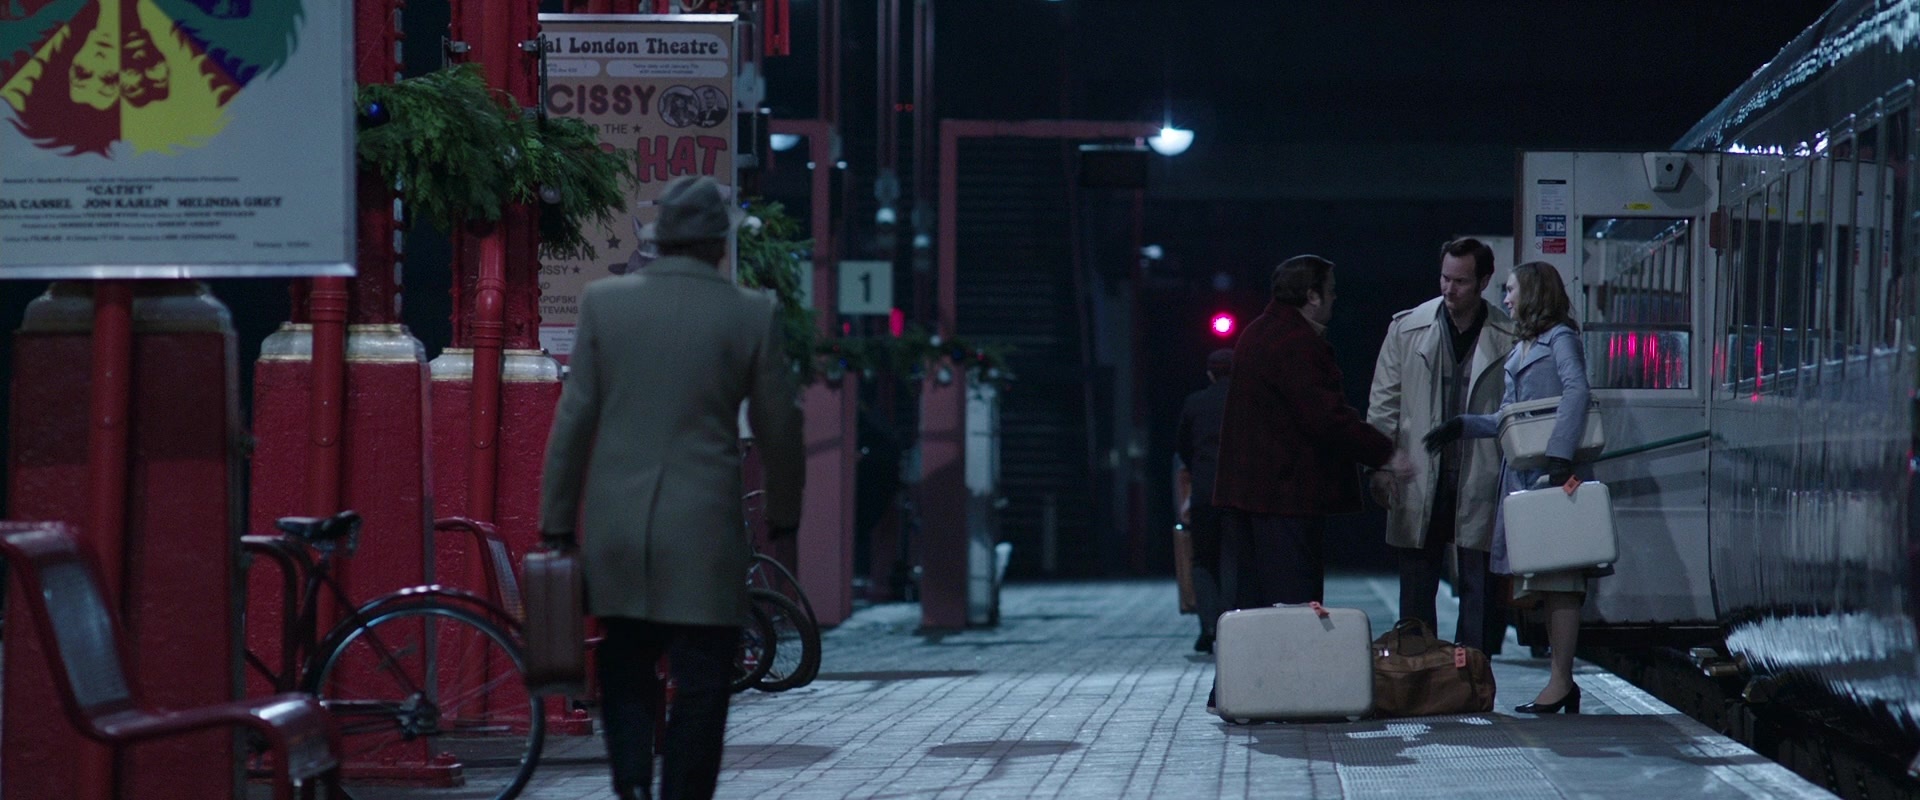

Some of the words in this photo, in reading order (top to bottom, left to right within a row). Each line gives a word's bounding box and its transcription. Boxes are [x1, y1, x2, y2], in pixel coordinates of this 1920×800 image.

[569, 37, 639, 54] London
[646, 38, 719, 54] Theatre
[548, 84, 656, 115] CISSY
[604, 124, 628, 135] THE
[636, 135, 728, 183] HAT
[20, 198, 72, 209] CASSEL
[83, 198, 111, 209] JON
[177, 197, 240, 208] MELINDA
[243, 197, 282, 208] GREY
[859, 272, 871, 303] 1
